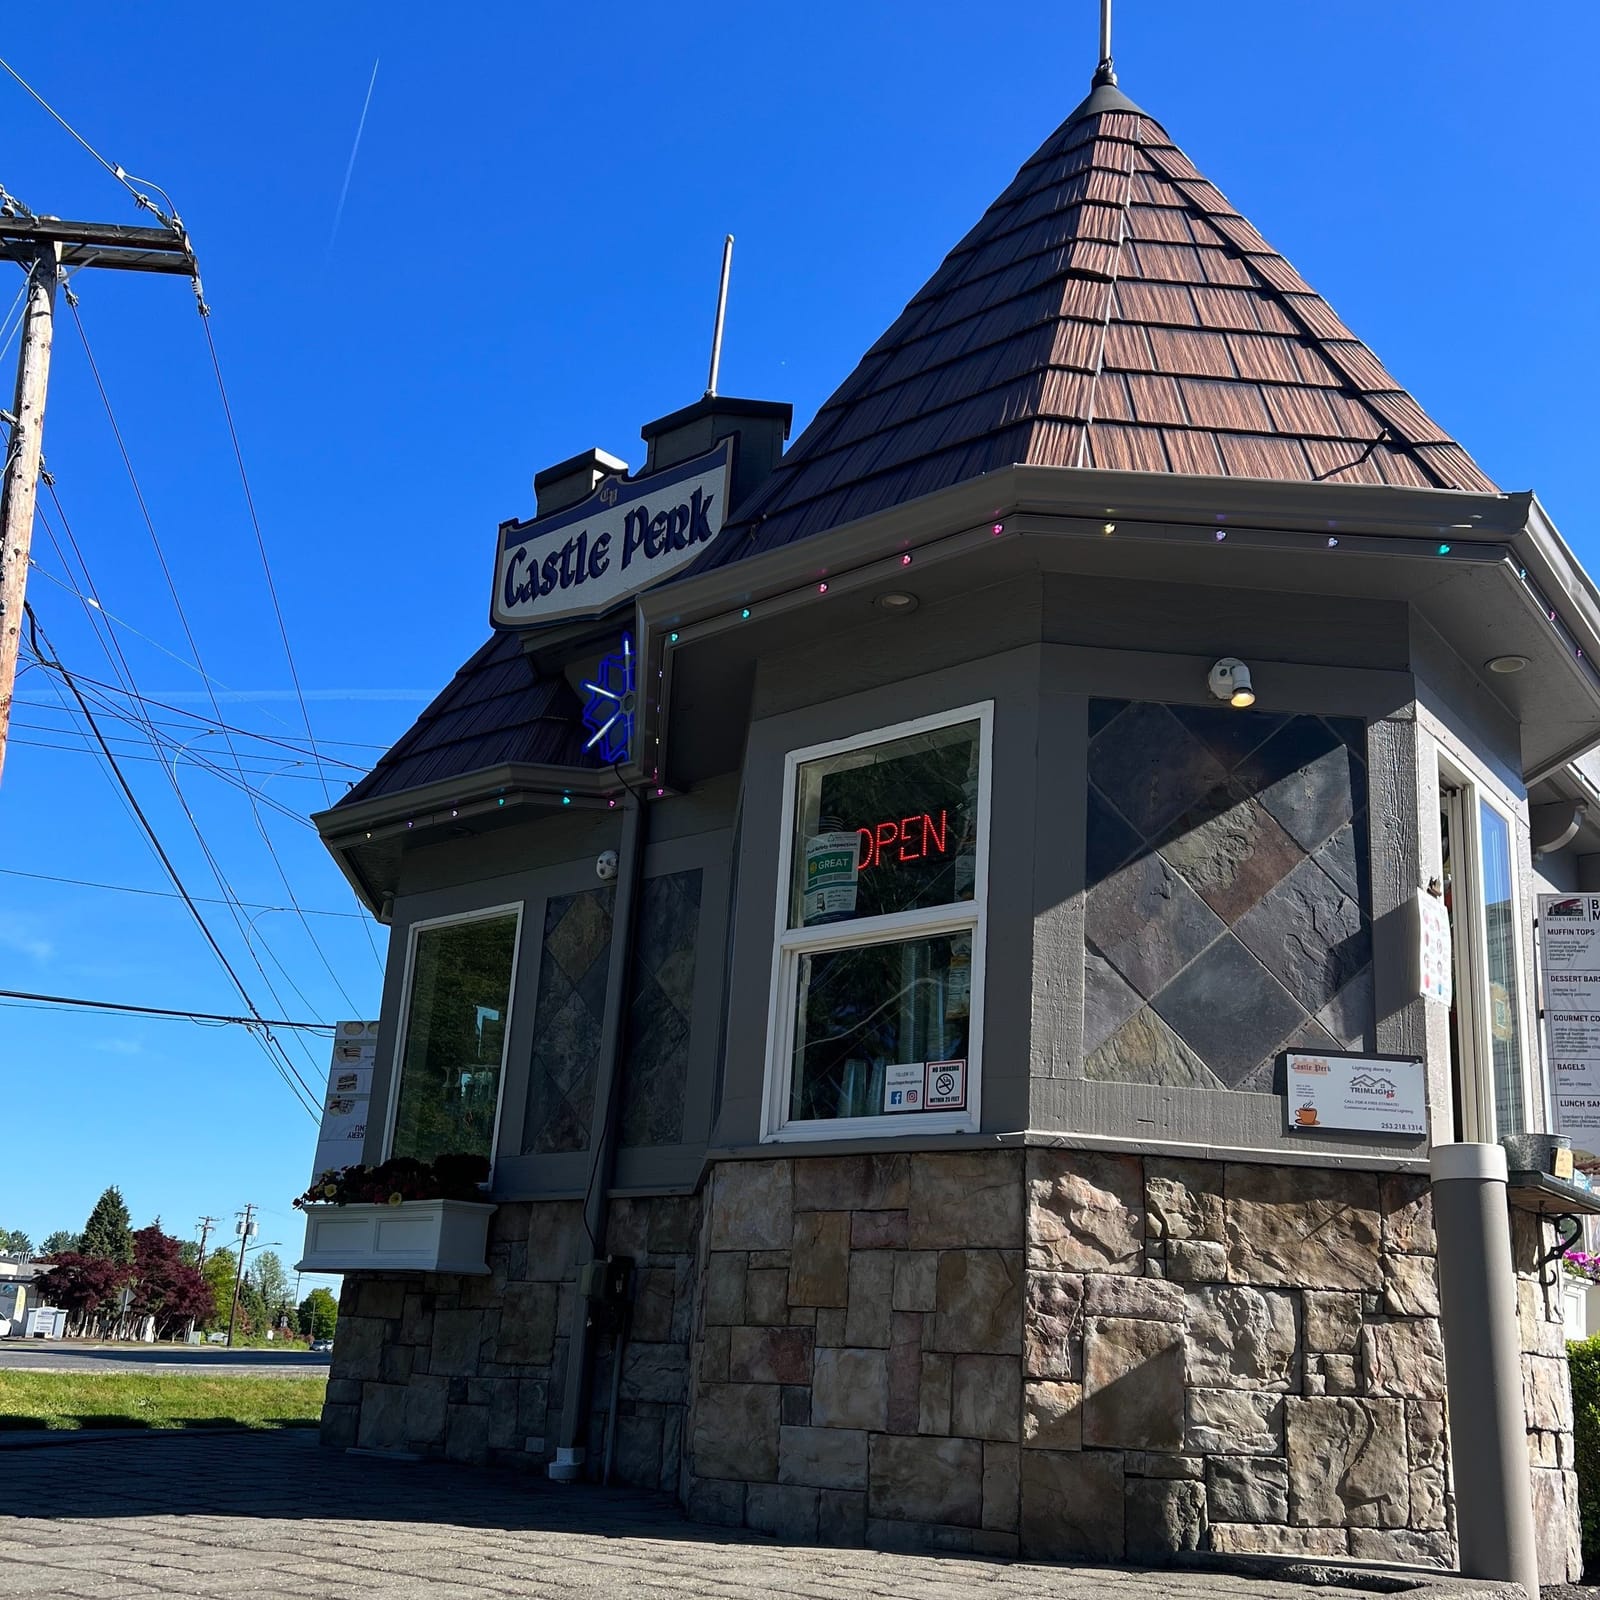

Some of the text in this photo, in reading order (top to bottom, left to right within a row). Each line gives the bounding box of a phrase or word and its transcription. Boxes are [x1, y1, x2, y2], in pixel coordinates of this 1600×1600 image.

[504, 485, 715, 609] Castle Perk
[856, 809, 948, 871] OPEN
[818, 858, 849, 870] GREAT
[1350, 1087, 1395, 1096] TRIMLIGHT
[1381, 1122, 1423, 1132] 253.218.1314
